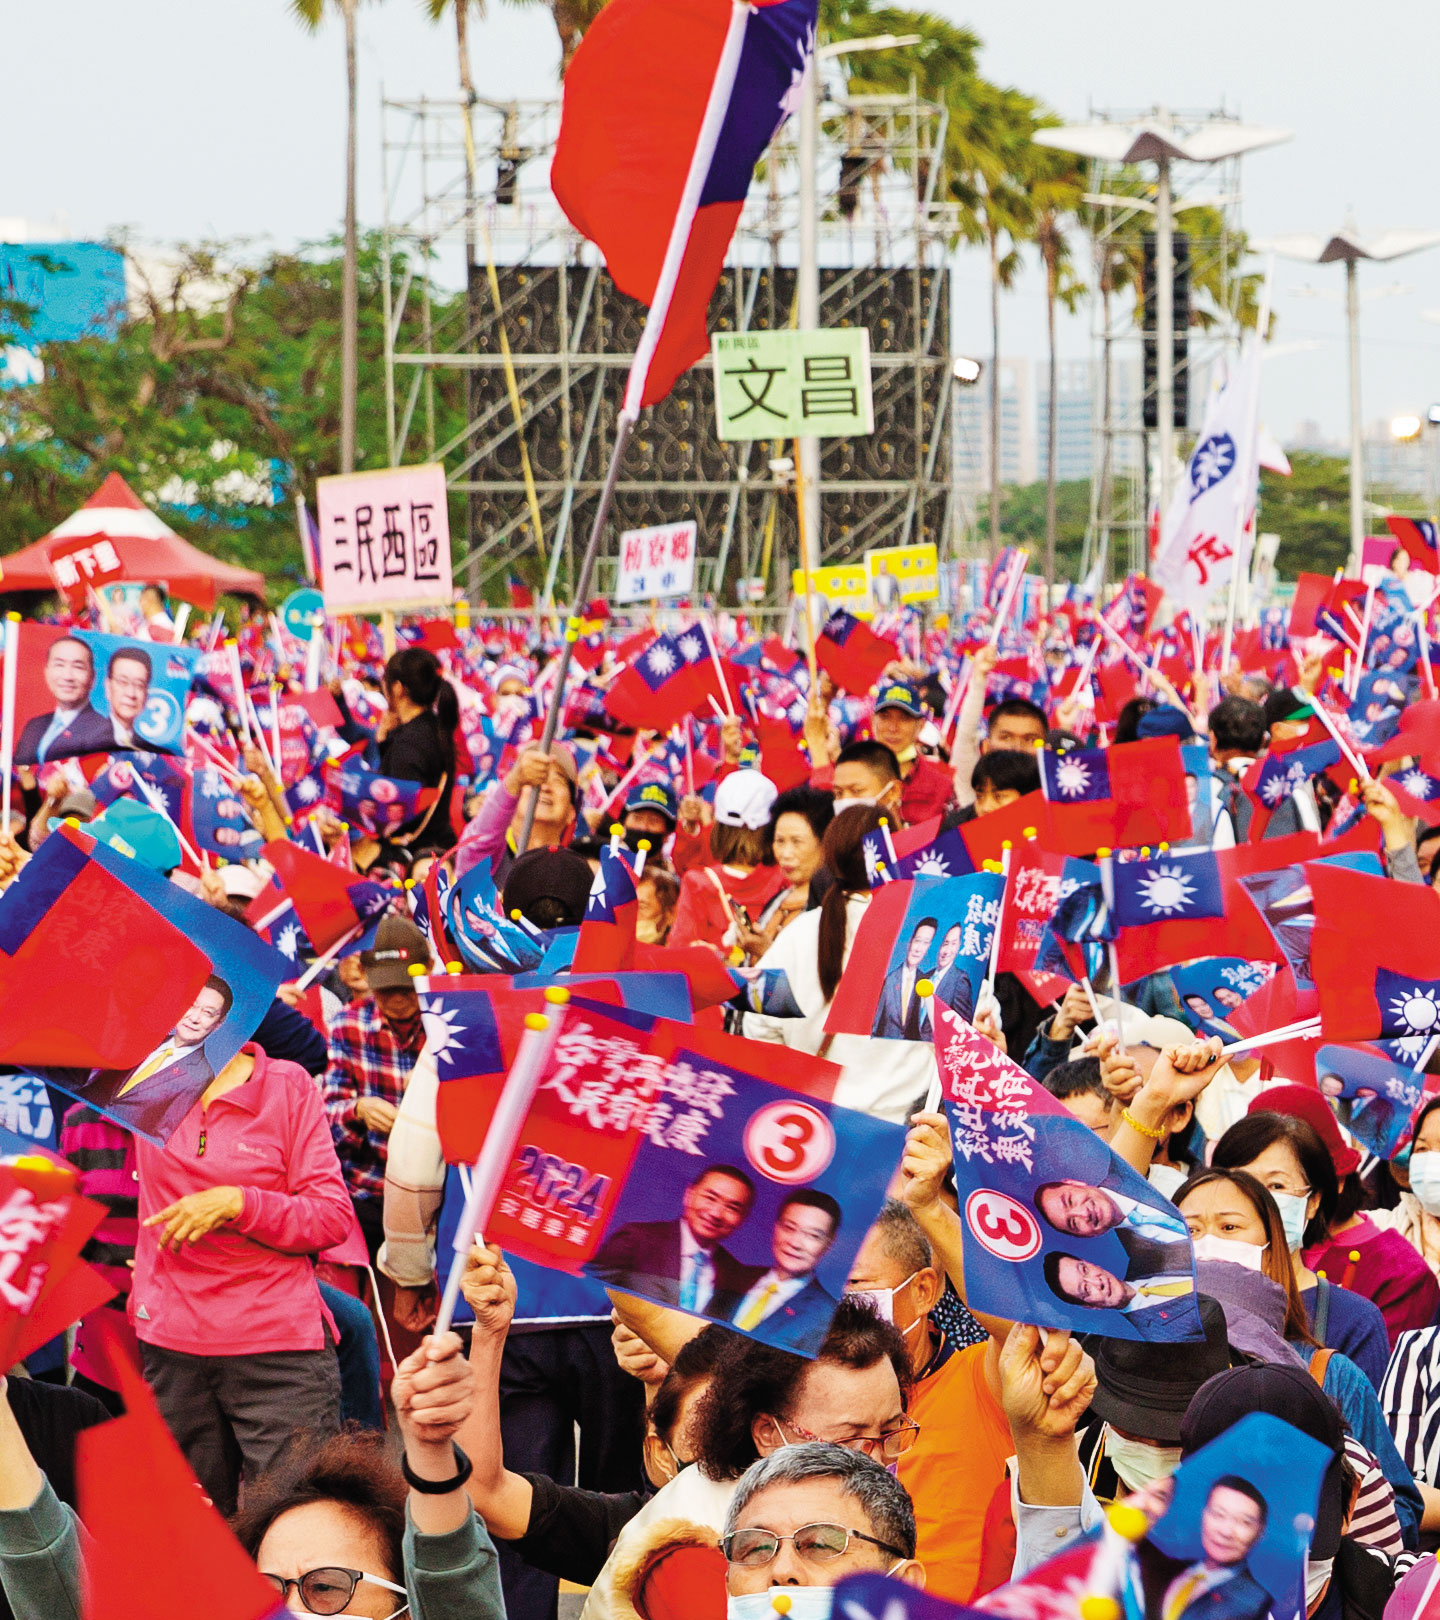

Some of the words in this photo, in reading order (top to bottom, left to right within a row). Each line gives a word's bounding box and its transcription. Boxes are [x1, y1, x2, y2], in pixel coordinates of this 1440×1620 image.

[724, 355, 858, 421] 文昌
[333, 502, 441, 583] 三民西區
